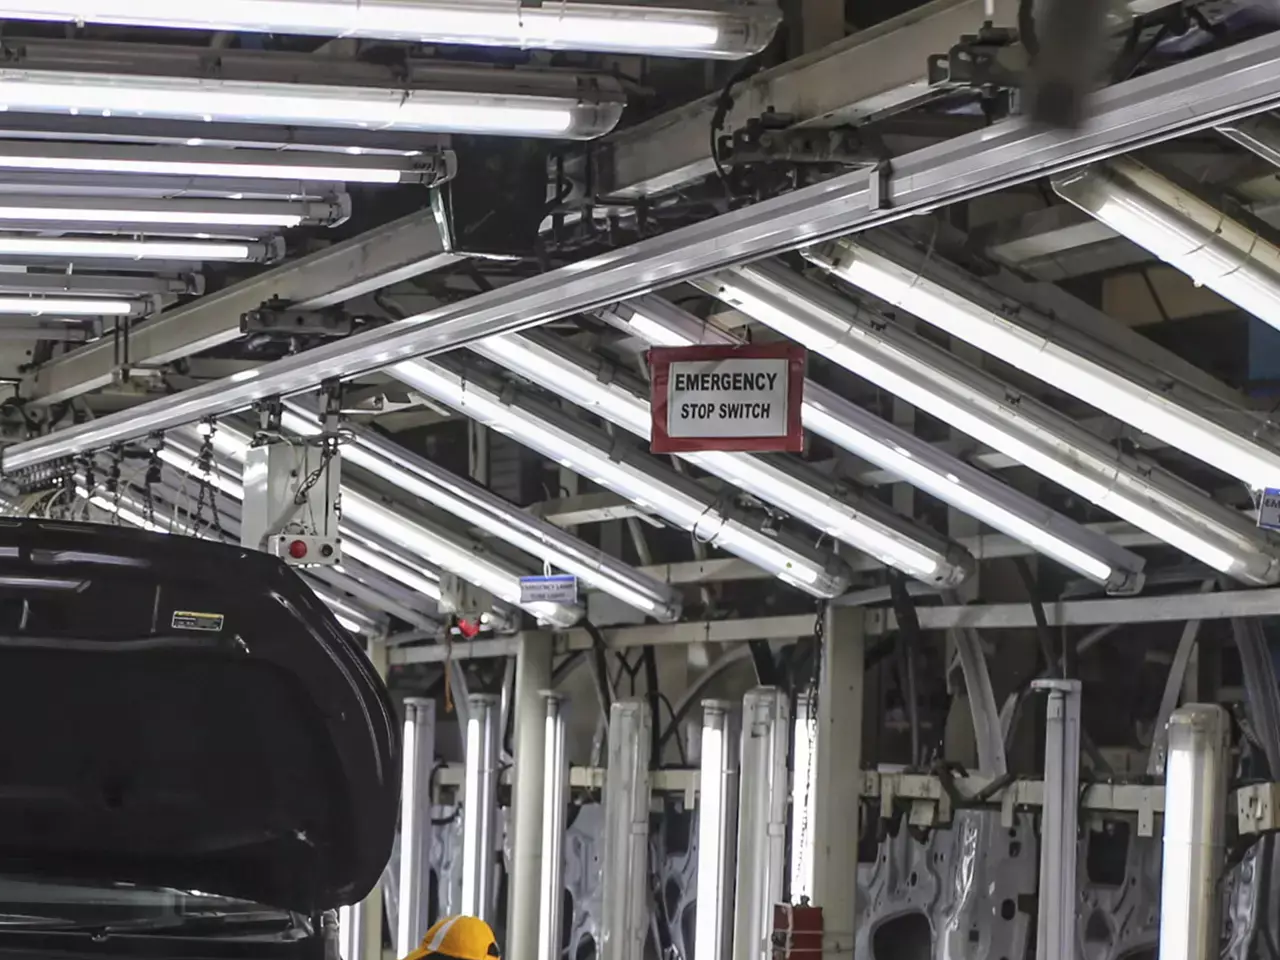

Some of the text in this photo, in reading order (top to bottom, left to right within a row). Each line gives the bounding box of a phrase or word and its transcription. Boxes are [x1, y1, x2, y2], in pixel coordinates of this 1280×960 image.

[674, 373, 777, 391] EMERGENCY
[680, 403, 770, 419] STOP SWITCH
